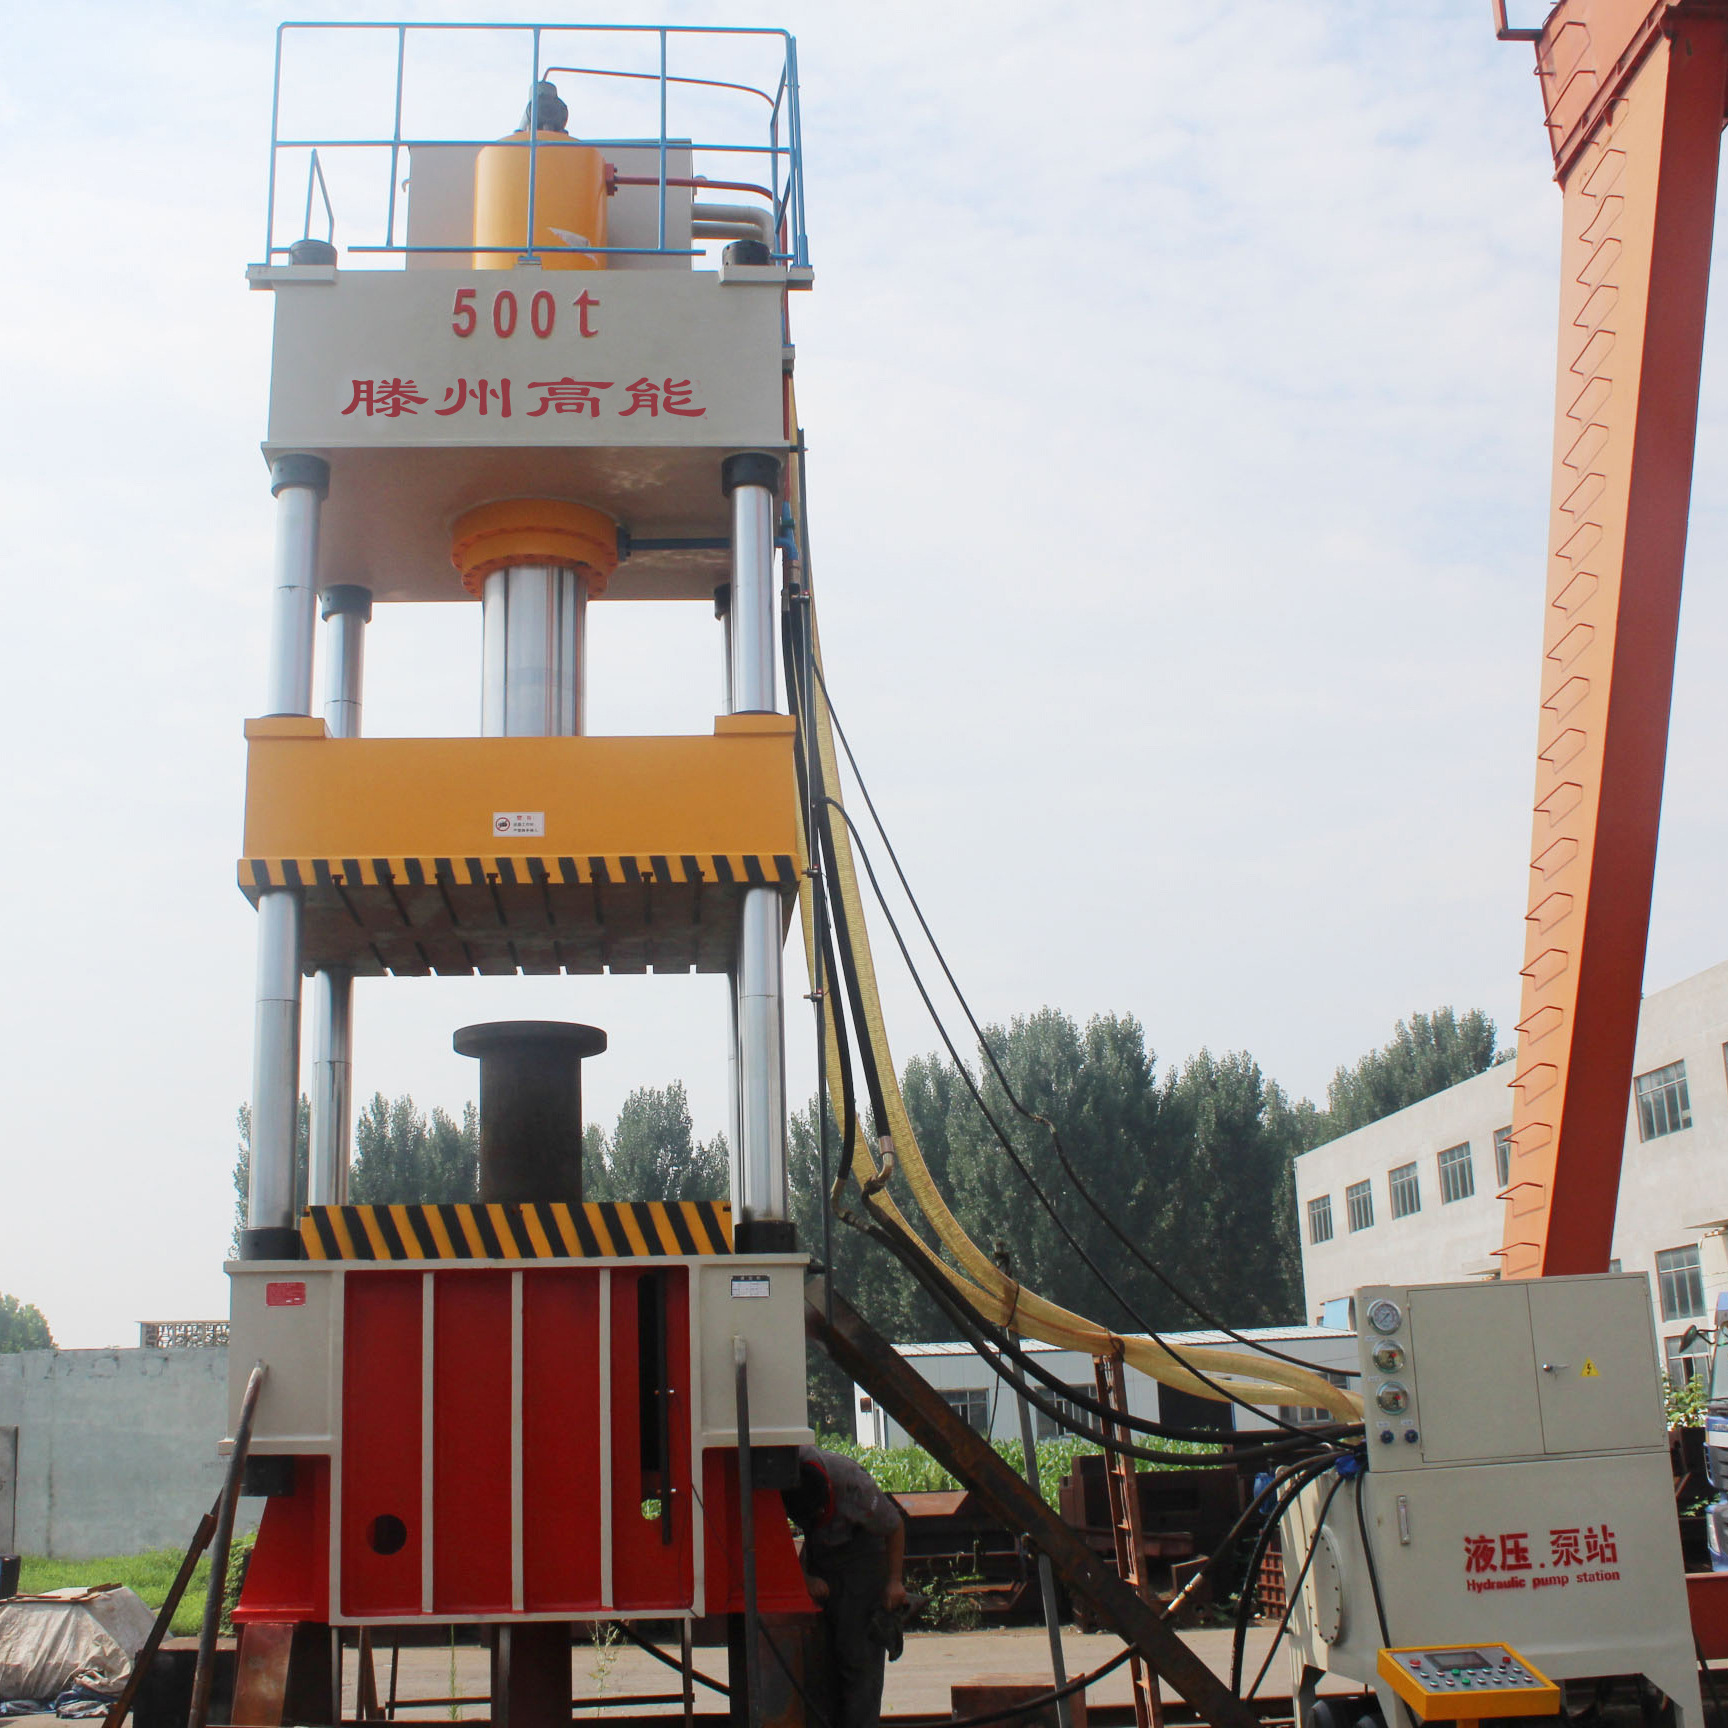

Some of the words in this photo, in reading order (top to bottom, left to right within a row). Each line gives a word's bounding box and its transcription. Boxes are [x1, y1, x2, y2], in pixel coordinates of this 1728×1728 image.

[452, 288, 600, 339] 500t
[341, 376, 707, 418] 滕州高能
[1466, 1576, 1526, 1593] Hydraulic
[1532, 1574, 1570, 1590] pump
[1576, 1570, 1621, 1584] station
